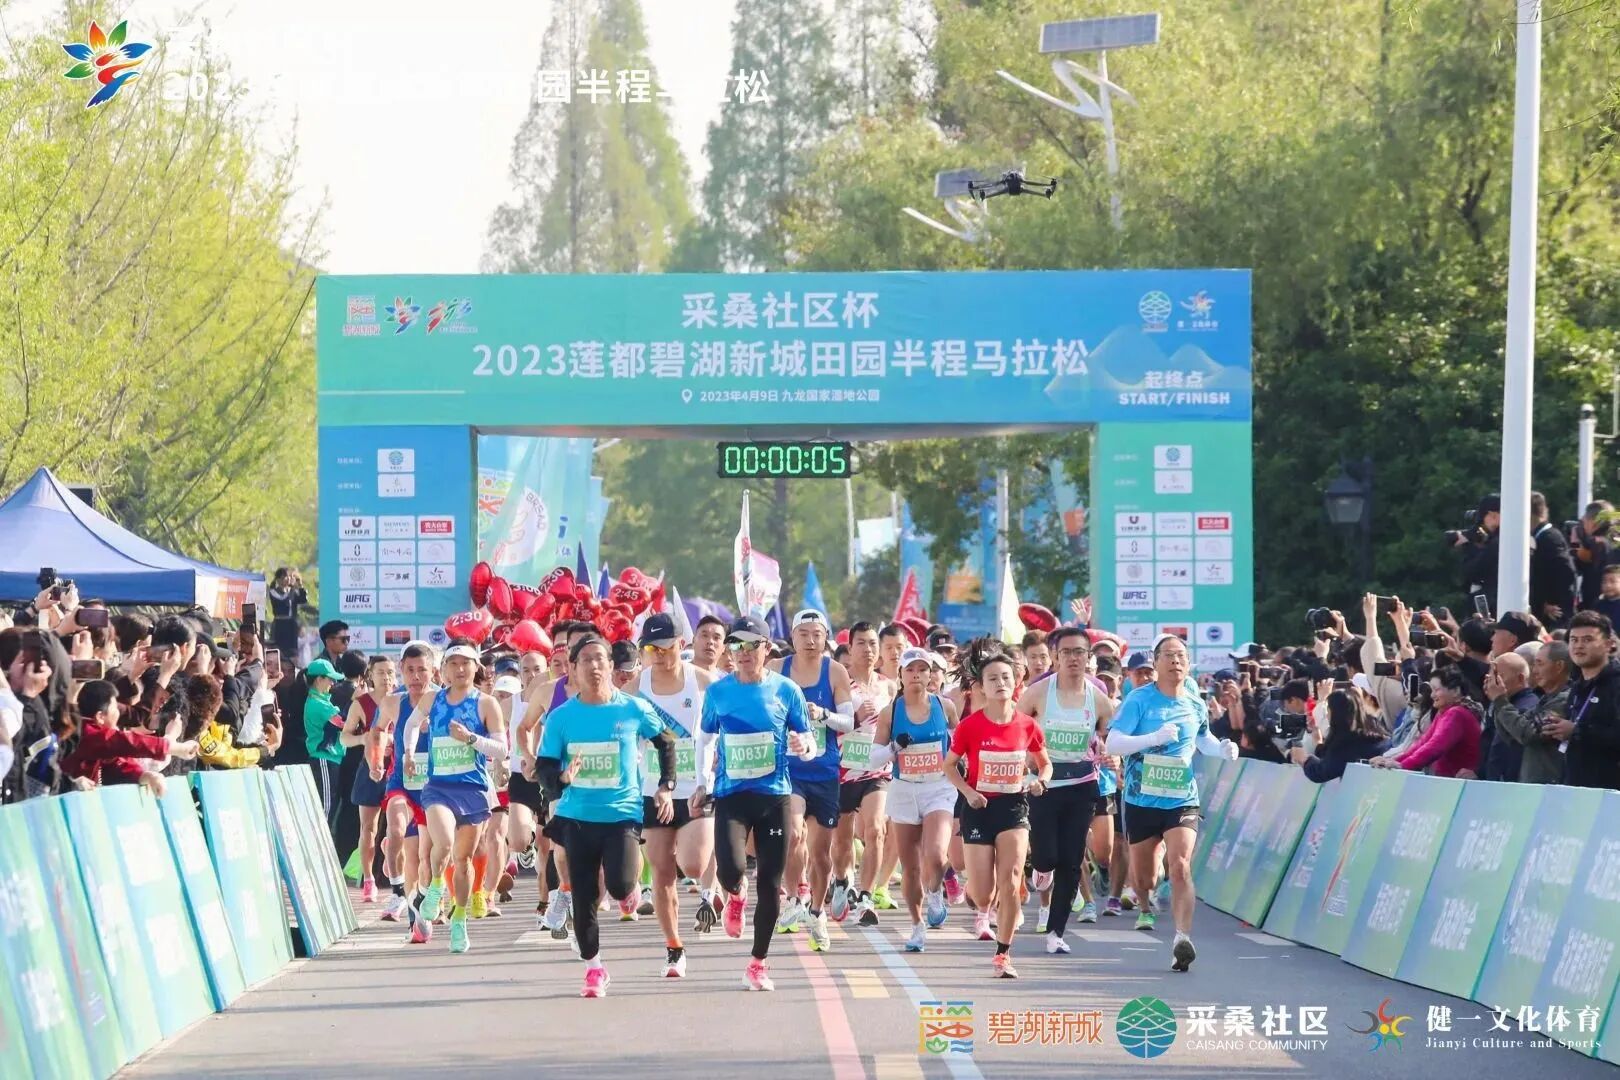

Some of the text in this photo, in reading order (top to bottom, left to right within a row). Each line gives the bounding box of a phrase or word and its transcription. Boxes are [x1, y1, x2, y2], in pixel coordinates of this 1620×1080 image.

[682, 290, 880, 329] 采桑社区杯
[472, 339, 1089, 379] 2023莲都碧湖新城田园半程马拉松
[1144, 370, 1204, 389] 起终点
[700, 389, 779, 403] 2023年4月9日
[1119, 391, 1231, 407] START/FINISH
[724, 446, 846, 474] 00:00:05
[615, 588, 640, 601] 2:45
[451, 611, 483, 626] 2:30
[1050, 731, 1086, 745] A0087
[731, 745, 768, 762] A0837
[848, 742, 870, 756] A00
[581, 756, 613, 770] 0156
[904, 753, 938, 768] B2329
[1147, 766, 1184, 782] A0932
